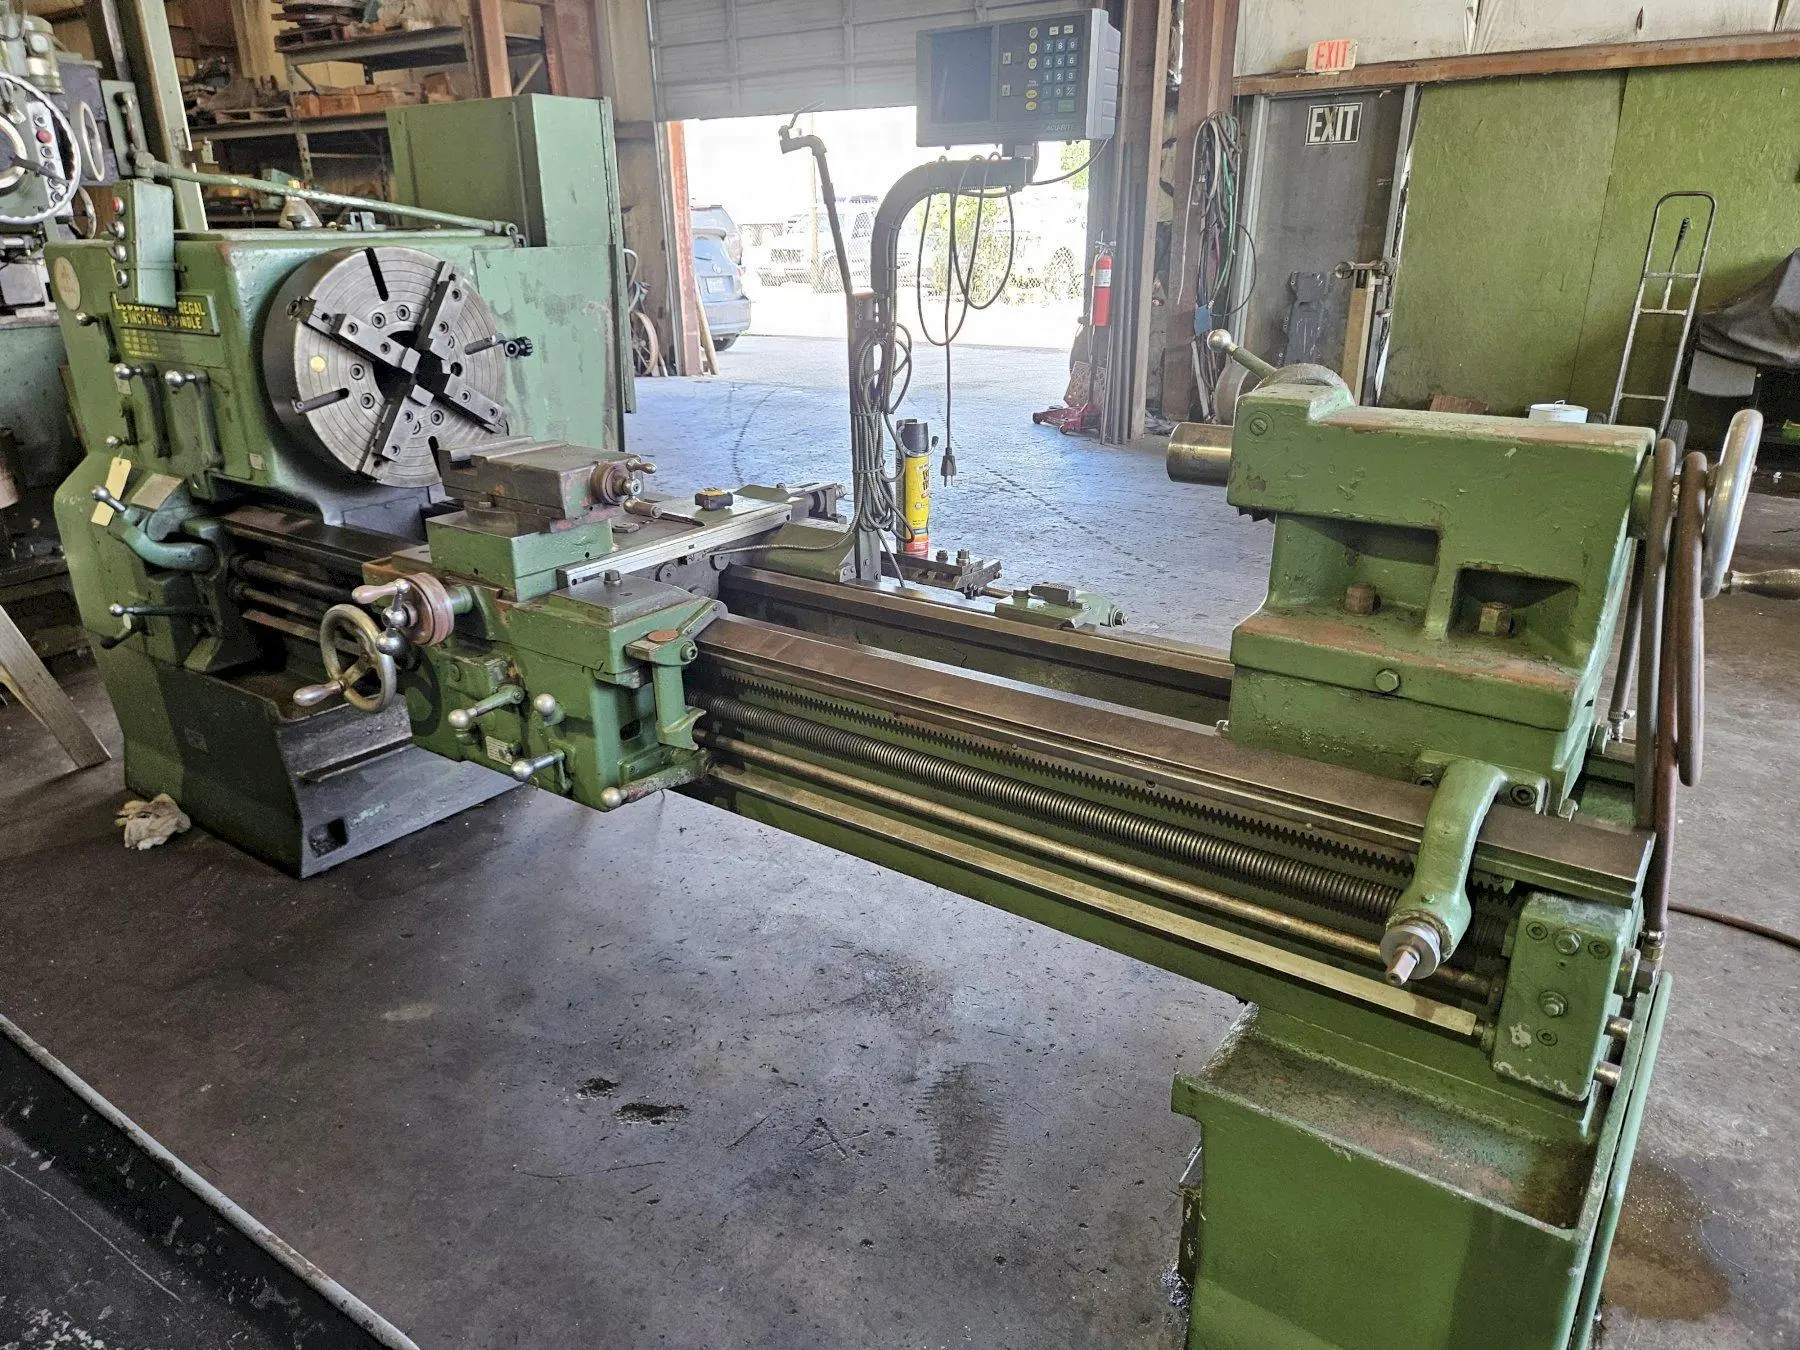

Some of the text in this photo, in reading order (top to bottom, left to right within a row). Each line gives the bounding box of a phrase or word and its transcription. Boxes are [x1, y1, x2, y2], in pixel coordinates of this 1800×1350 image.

[1315, 41, 1350, 70] EXIT
[1309, 105, 1359, 142] EXIT
[122, 311, 129, 324] 5
[129, 312, 147, 325] INCH
[178, 301, 206, 316] REGAL
